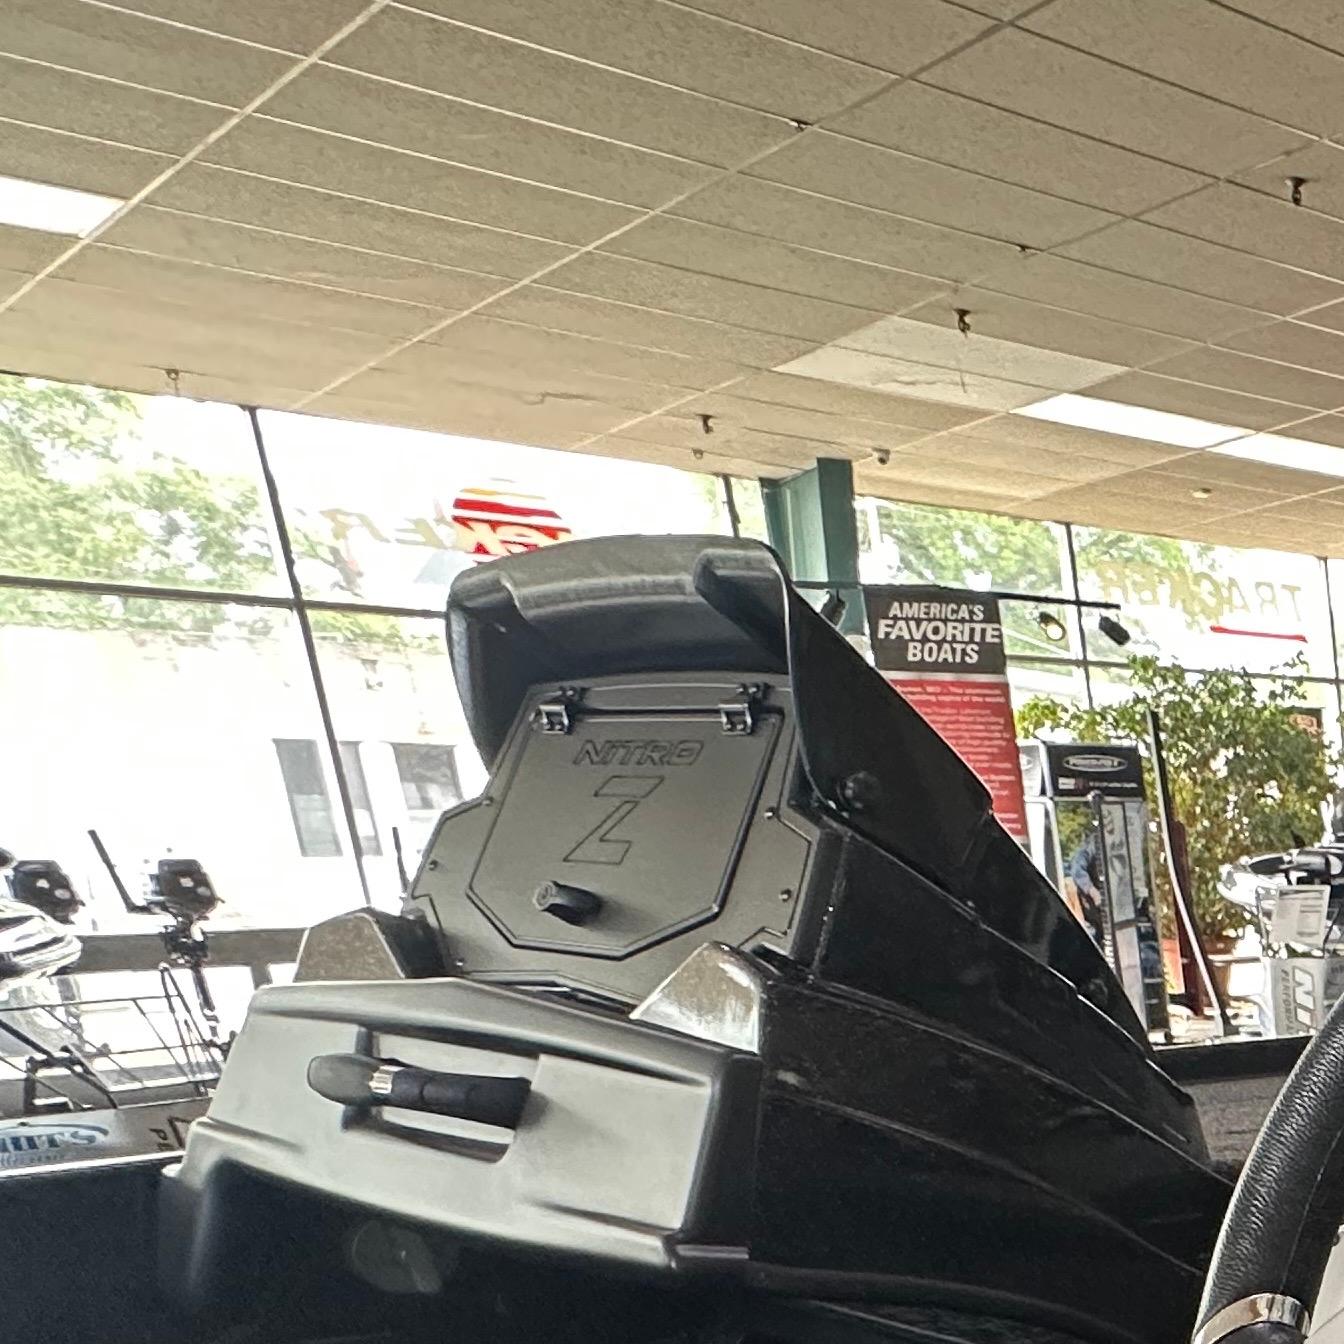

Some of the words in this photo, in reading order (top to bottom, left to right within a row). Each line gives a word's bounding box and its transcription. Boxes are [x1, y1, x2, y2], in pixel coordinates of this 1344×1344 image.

[888, 602, 984, 621] AMERICA'S
[877, 619, 1001, 643] FAVORITE
[907, 642, 979, 664] BOATS
[573, 739, 704, 766] NITRO
